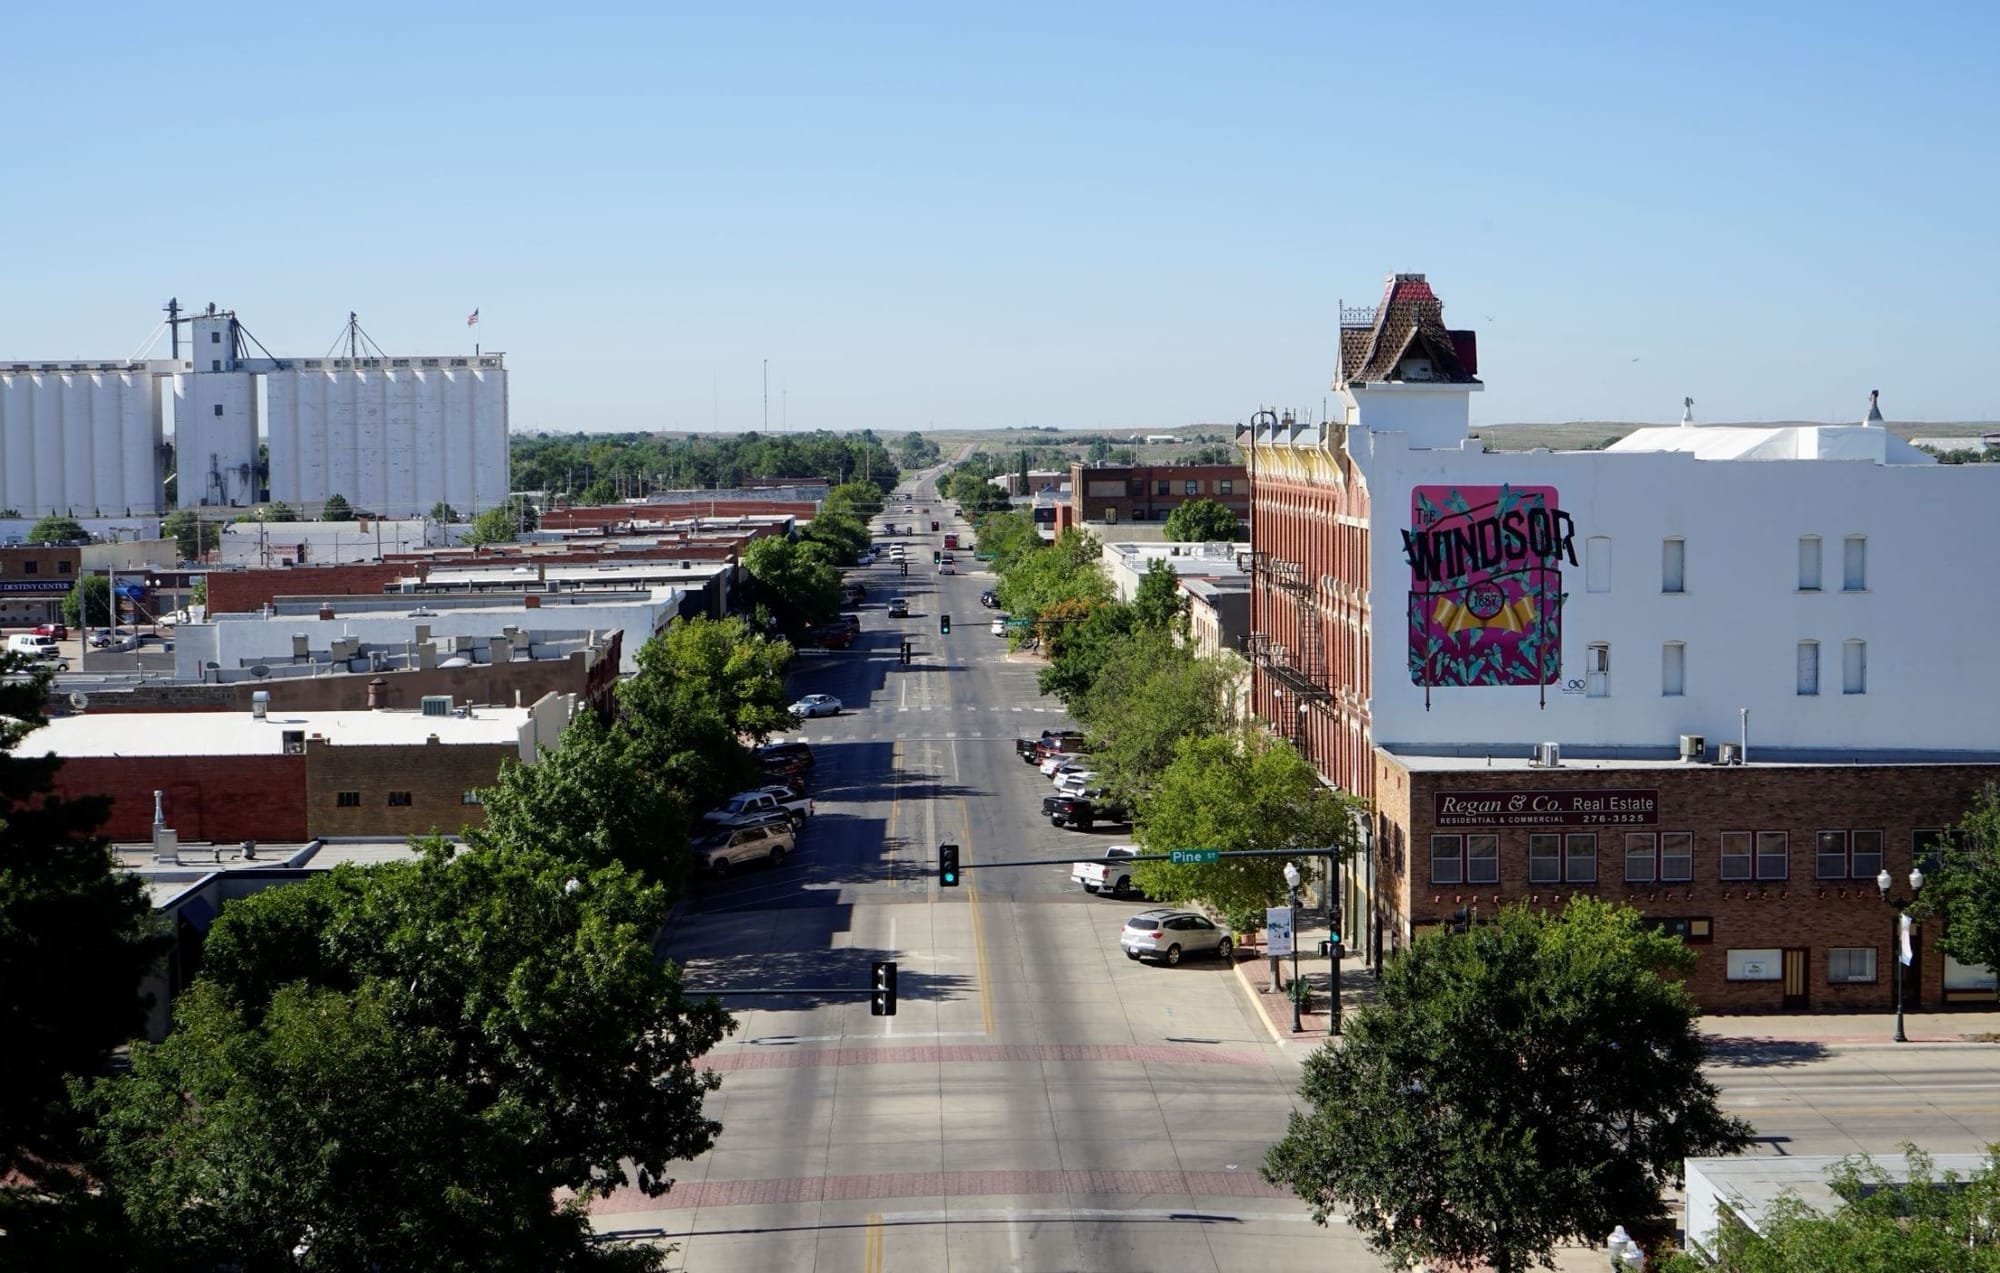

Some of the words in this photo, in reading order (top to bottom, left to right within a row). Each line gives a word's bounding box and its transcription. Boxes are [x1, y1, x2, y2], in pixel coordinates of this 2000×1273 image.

[1415, 508, 1436, 525] THE
[1400, 508, 1579, 581] WINDSOR
[1474, 594, 1498, 607] 1887
[1442, 797, 1501, 816] Regan
[1508, 795, 1527, 811] &
[1532, 795, 1562, 811] Co.
[1573, 797, 1604, 810] Real
[1610, 797, 1654, 810] Estate
[1583, 815, 1644, 823] 276-3525
[1172, 851, 1202, 863] Pine
